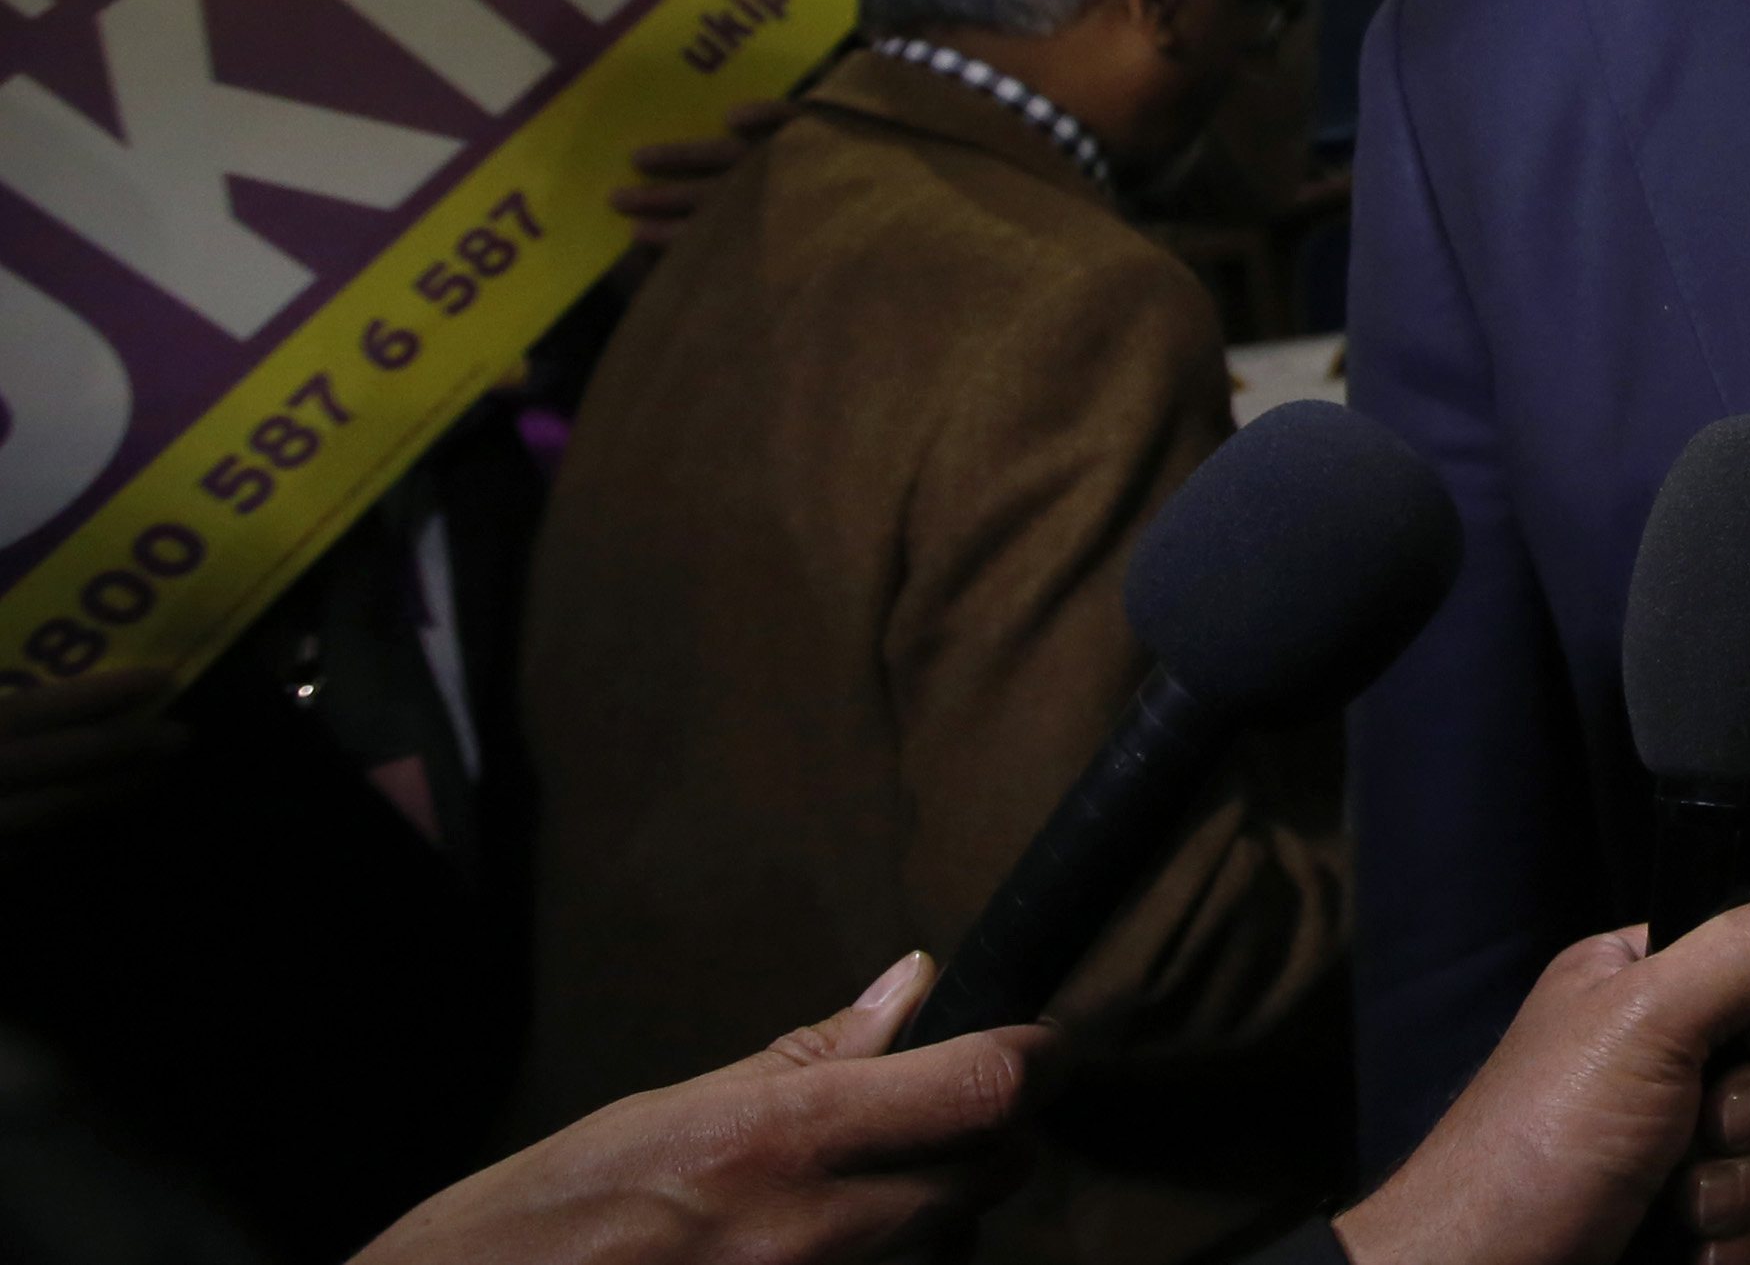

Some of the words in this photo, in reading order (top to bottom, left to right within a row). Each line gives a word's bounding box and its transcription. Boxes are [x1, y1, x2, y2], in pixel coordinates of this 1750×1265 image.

[0, 522, 207, 691] 800
[200, 372, 352, 515] 587
[360, 318, 421, 371] 6
[413, 191, 545, 316] 587
